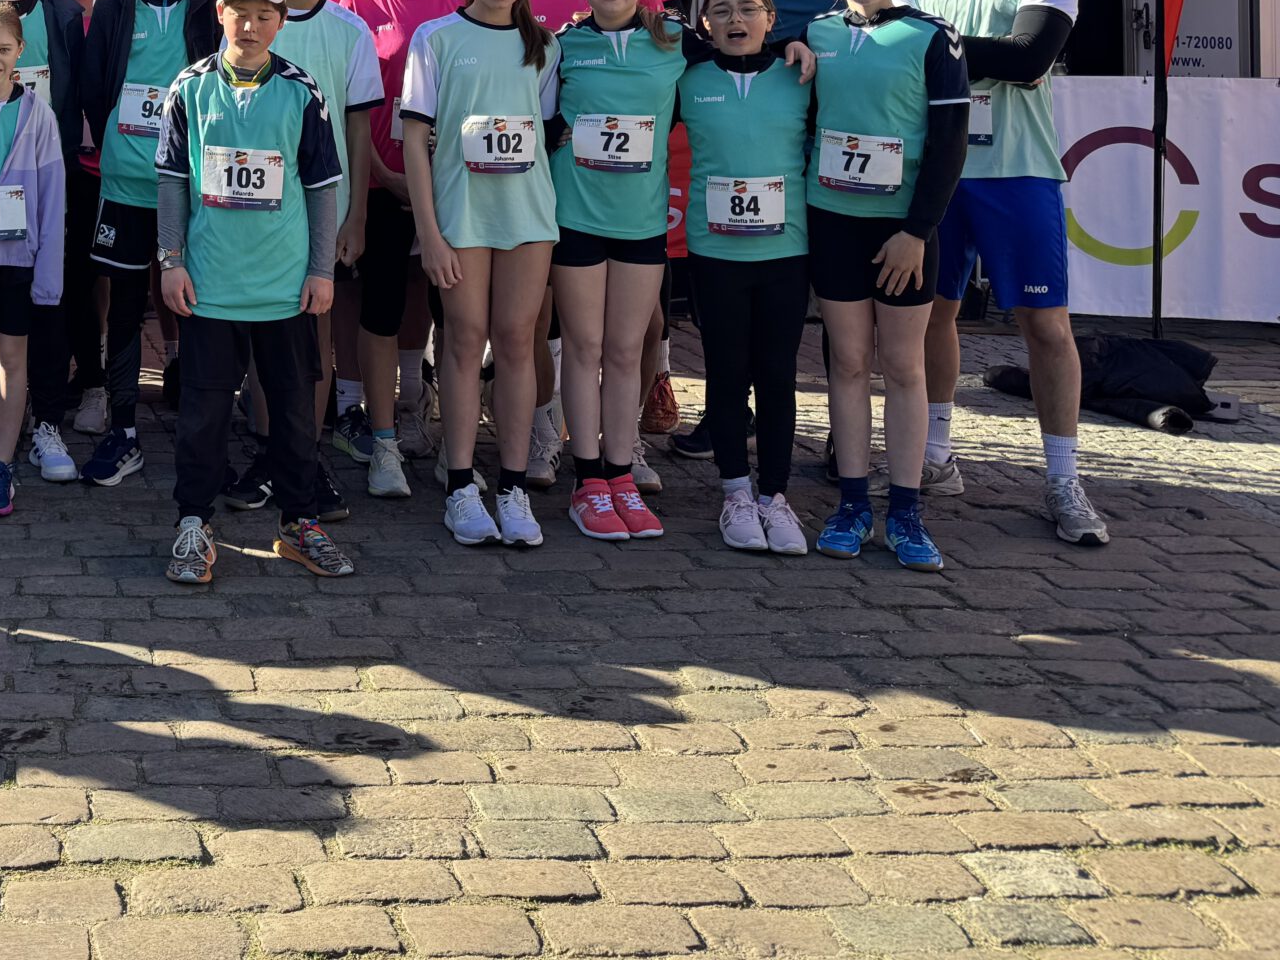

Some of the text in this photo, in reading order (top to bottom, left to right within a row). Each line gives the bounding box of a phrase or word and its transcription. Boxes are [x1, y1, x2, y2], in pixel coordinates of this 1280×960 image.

[694, 94, 725, 103] hummel
[141, 100, 164, 120] 94
[483, 133, 523, 154] 102
[600, 131, 630, 153] 72
[842, 150, 871, 174] 77
[223, 165, 266, 189] 103
[232, 189, 254, 197] Eduardo
[730, 195, 760, 216] 84
[1024, 285, 1048, 294] JAKO
